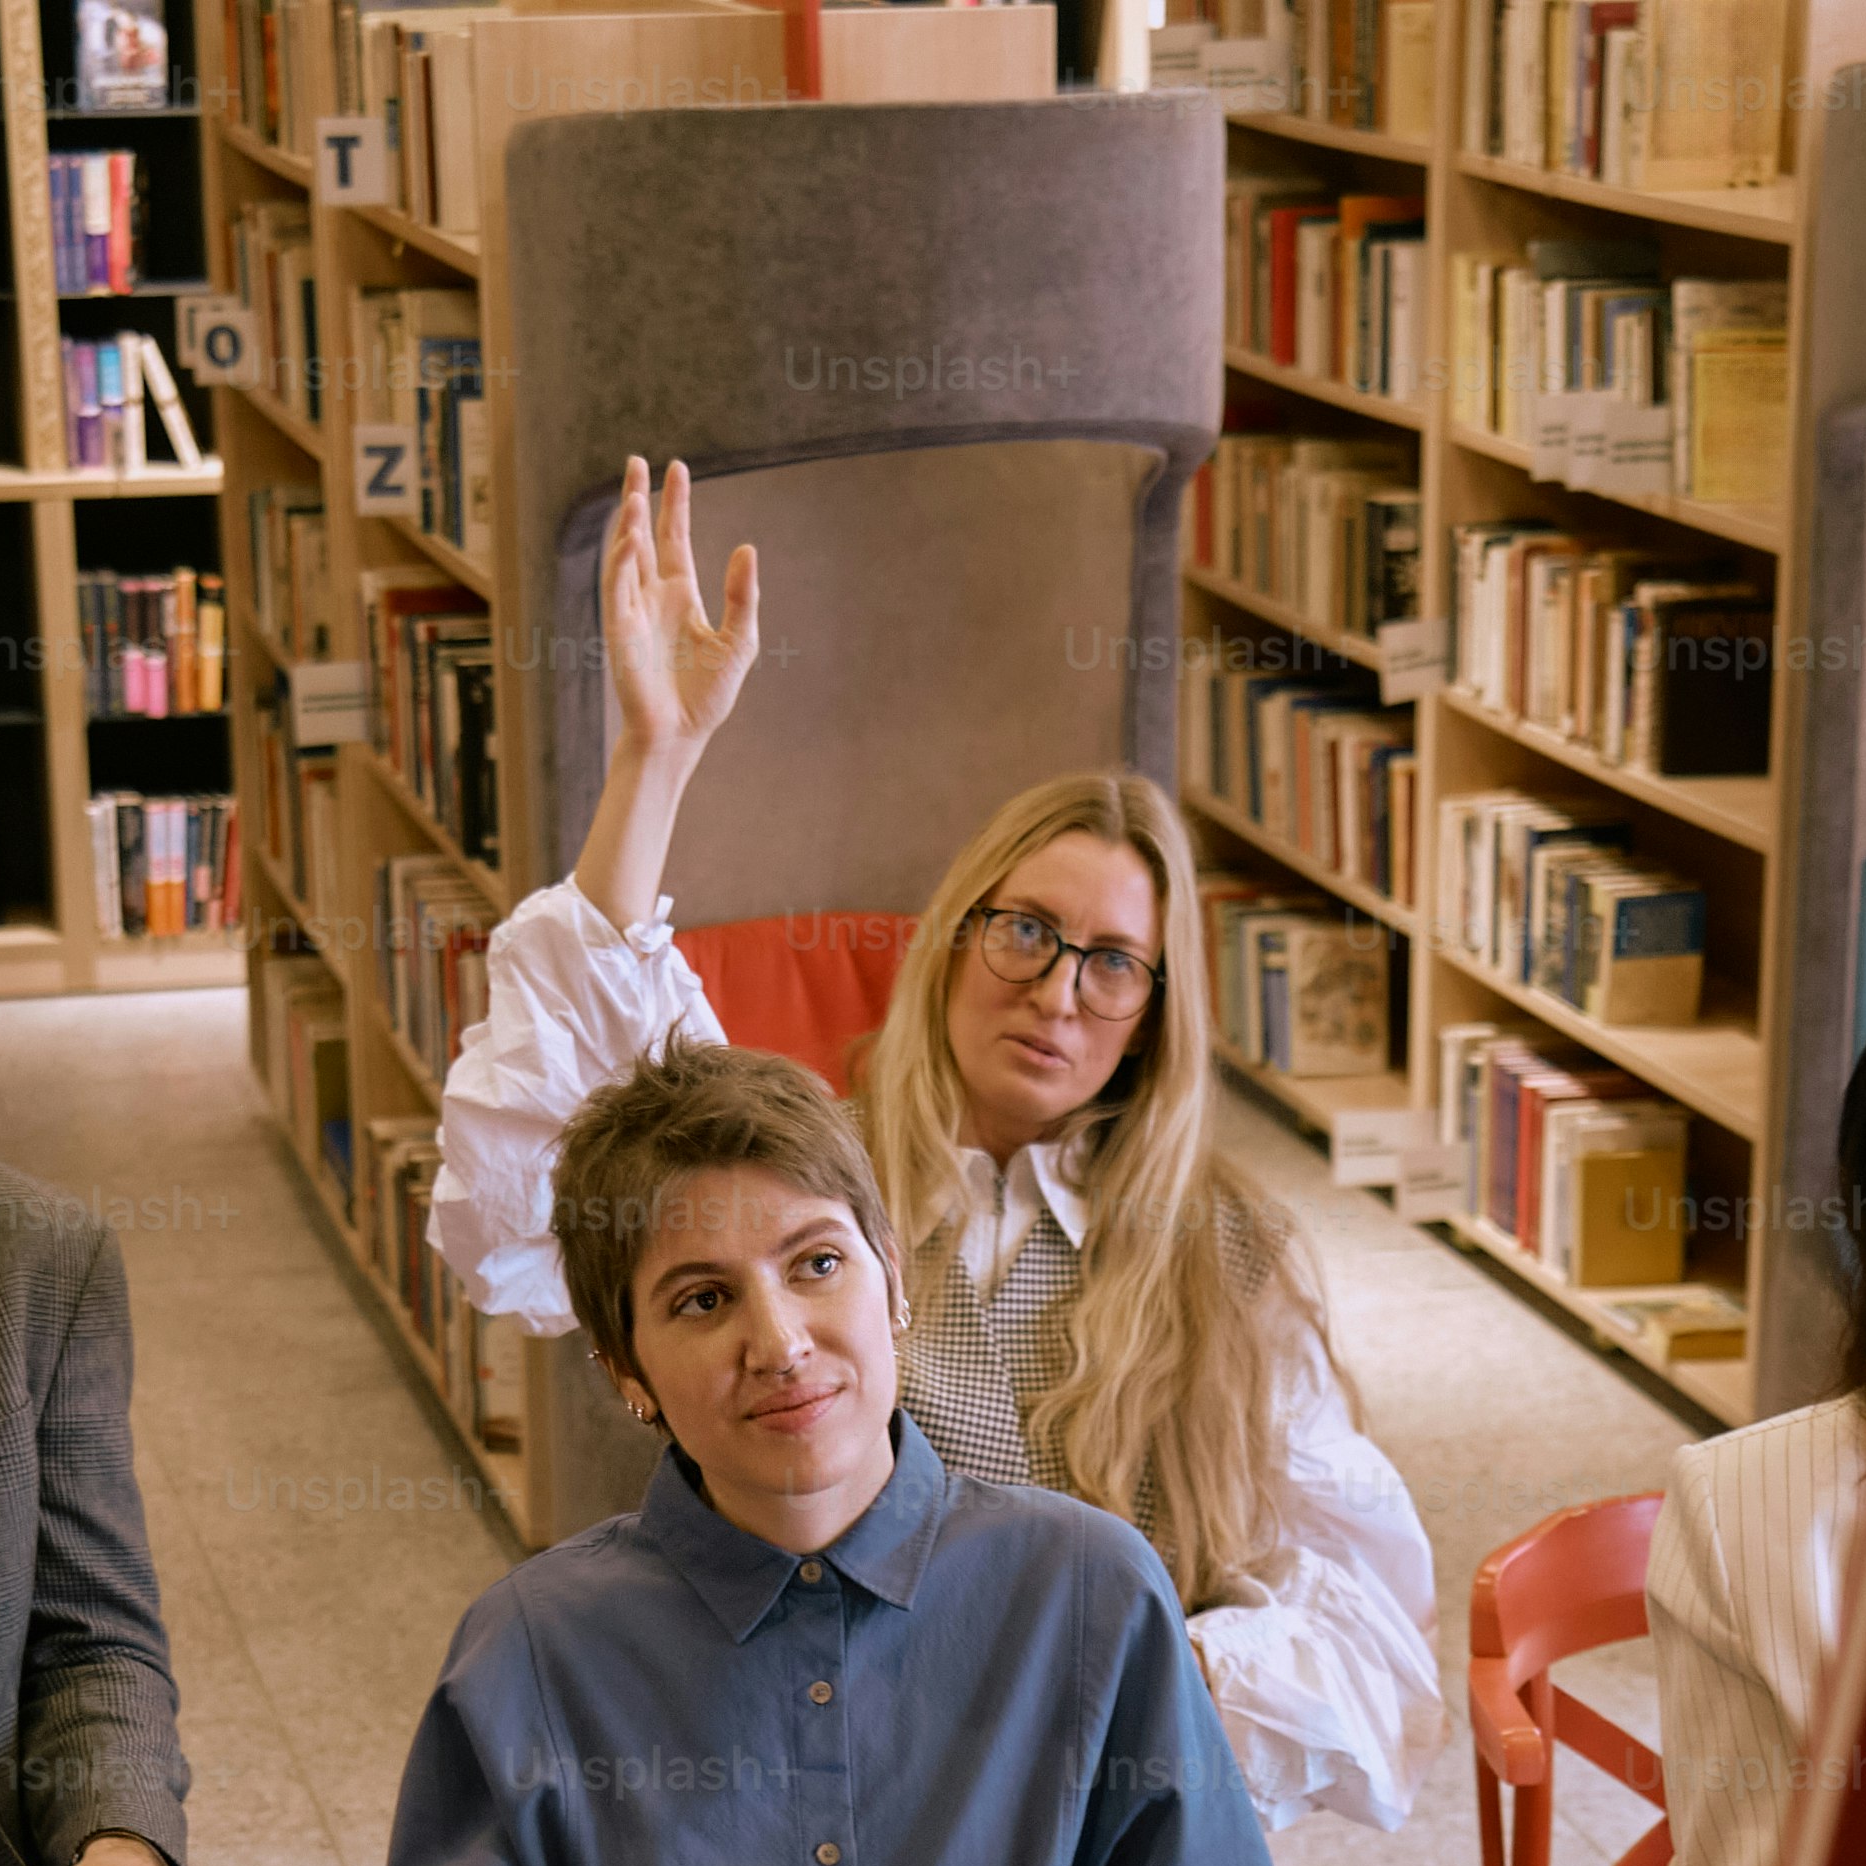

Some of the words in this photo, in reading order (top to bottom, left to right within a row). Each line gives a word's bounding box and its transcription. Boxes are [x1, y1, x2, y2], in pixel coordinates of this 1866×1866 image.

[325, 135, 361, 188] T
[205, 325, 242, 368] O
[364, 445, 405, 497] Z
